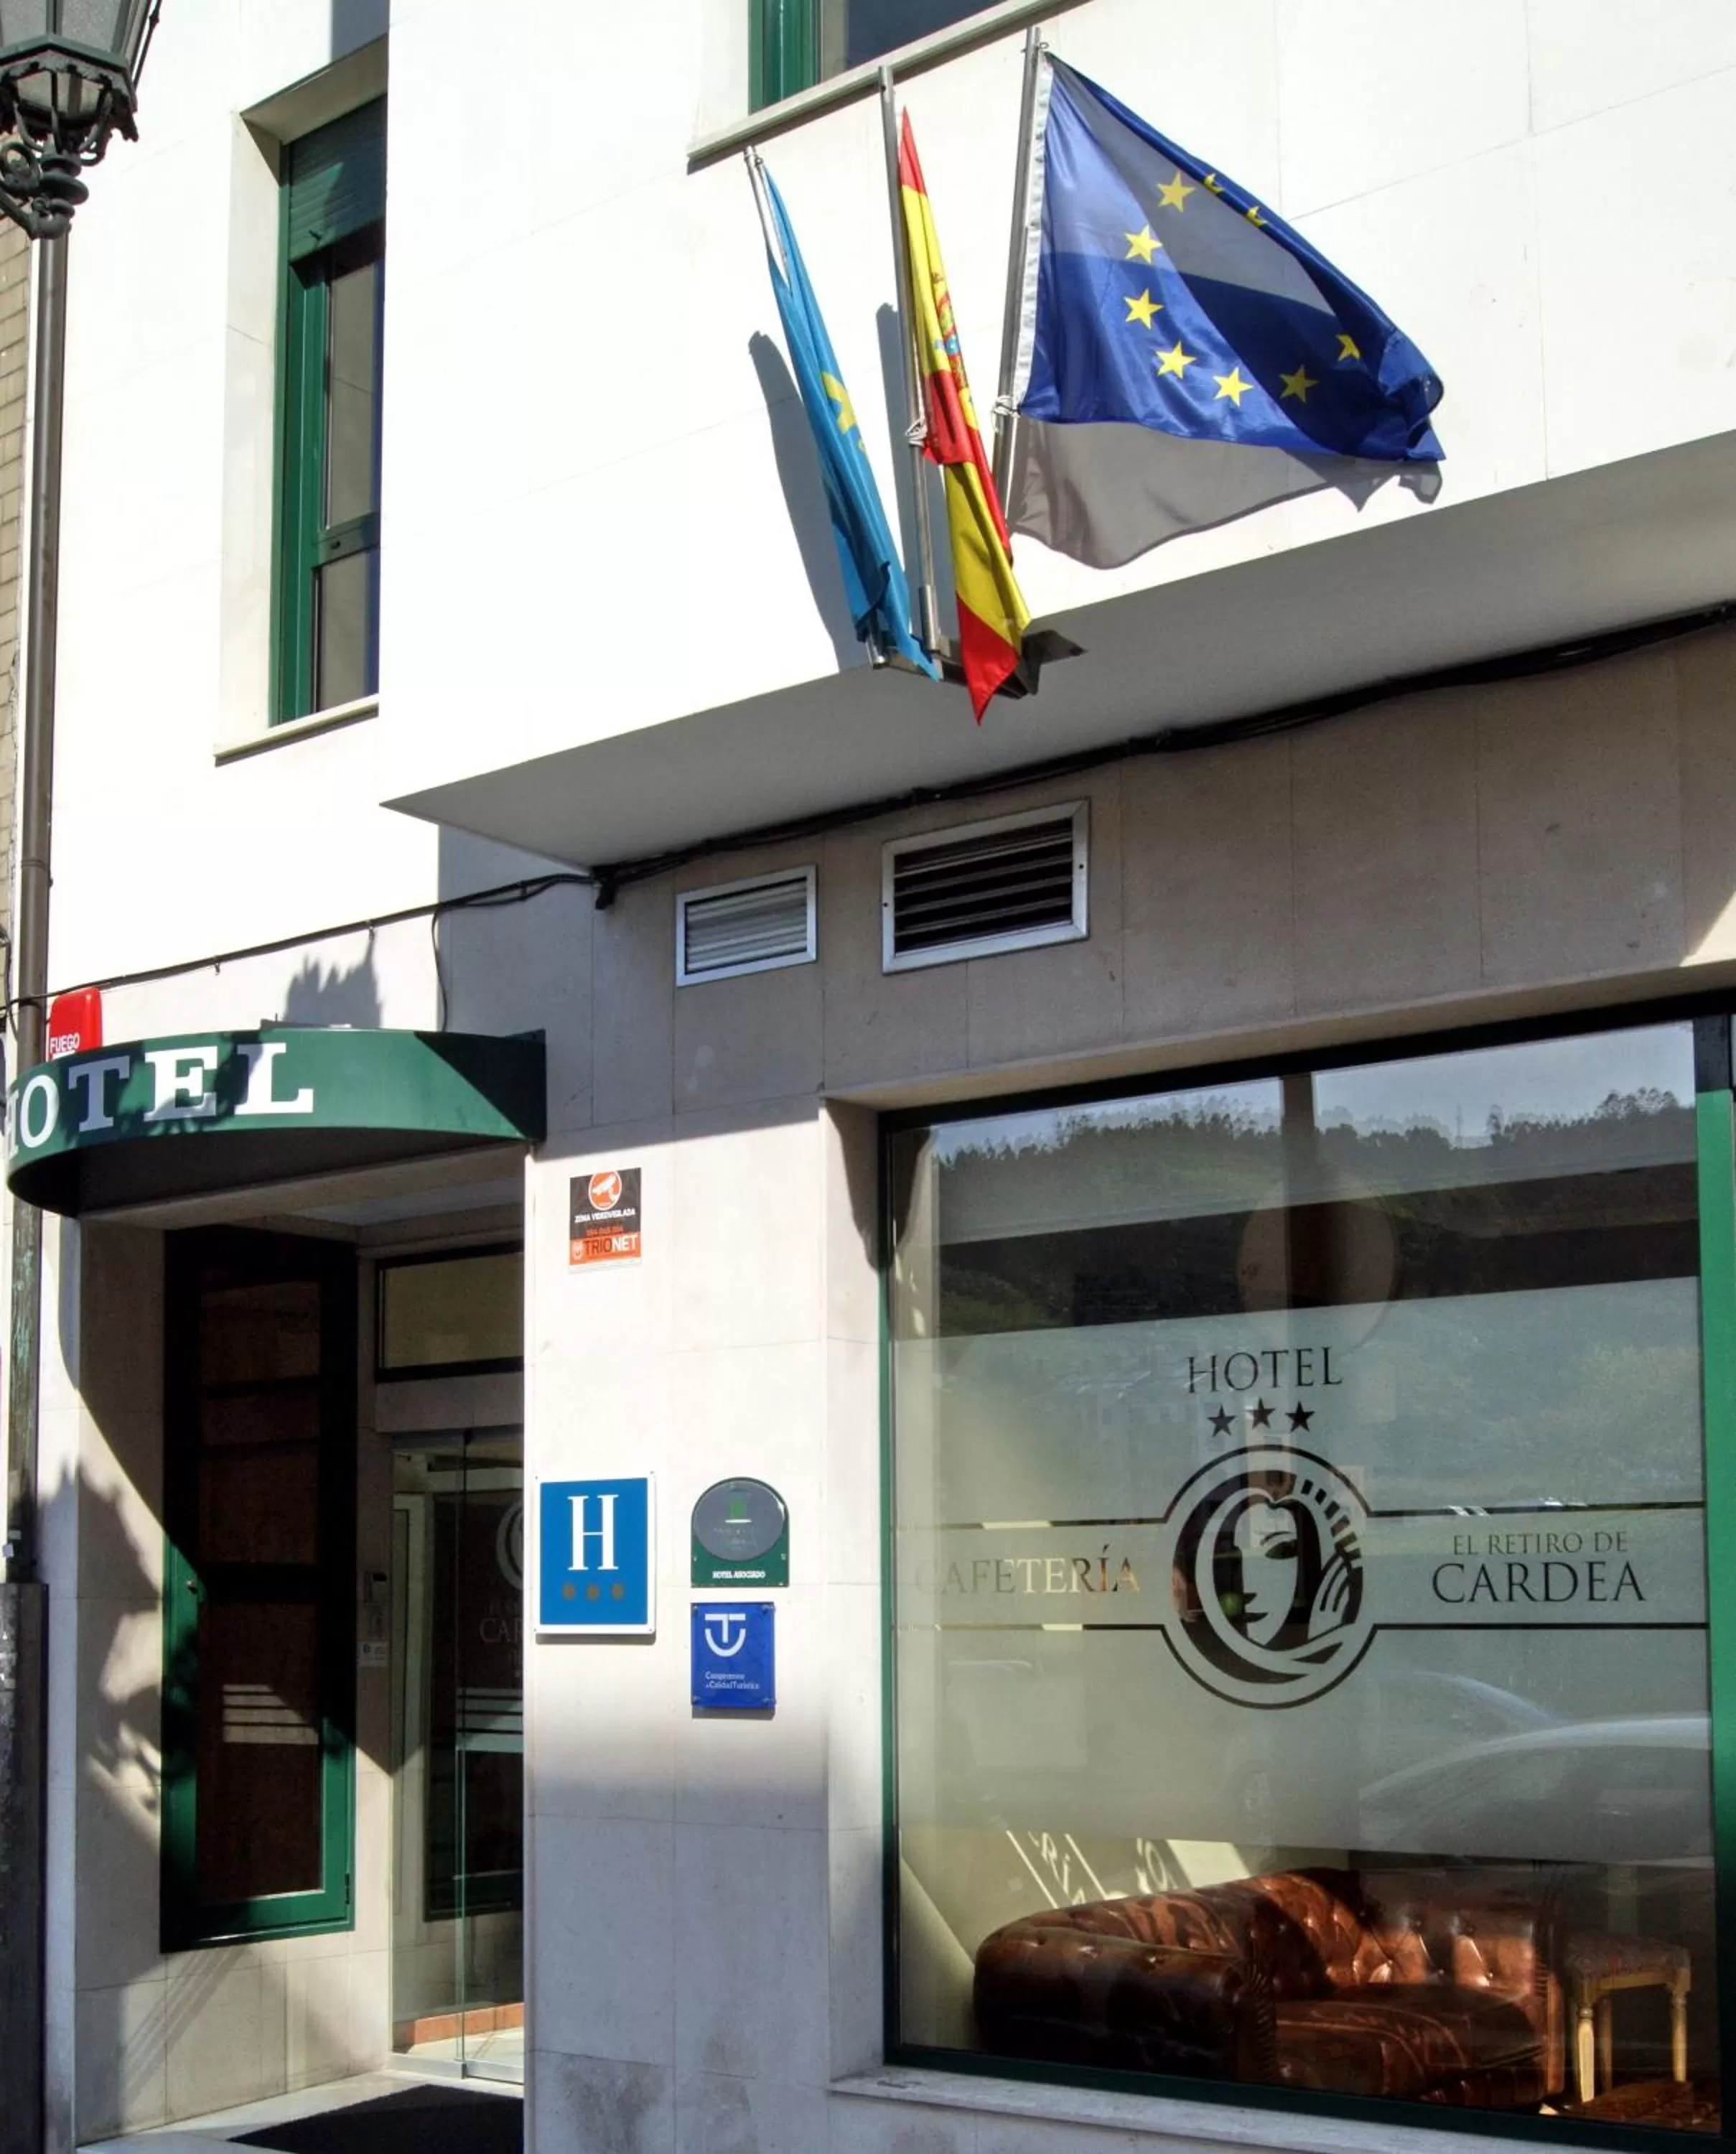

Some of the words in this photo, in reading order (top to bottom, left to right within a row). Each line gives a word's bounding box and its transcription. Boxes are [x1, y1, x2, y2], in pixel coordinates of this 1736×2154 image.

[50, 1032, 80, 1053] FUEGO
[584, 1234, 638, 1254] TRIONET
[1187, 1346, 1343, 1394] HOTEL
[567, 1493, 619, 1571] H
[1453, 1534, 1479, 1555] EL
[1488, 1531, 1583, 1555] RETIRO
[1594, 1531, 1628, 1552] DE
[915, 1544, 1141, 1595] CAFETERÍA
[1432, 1560, 1647, 1603] CARDEA
